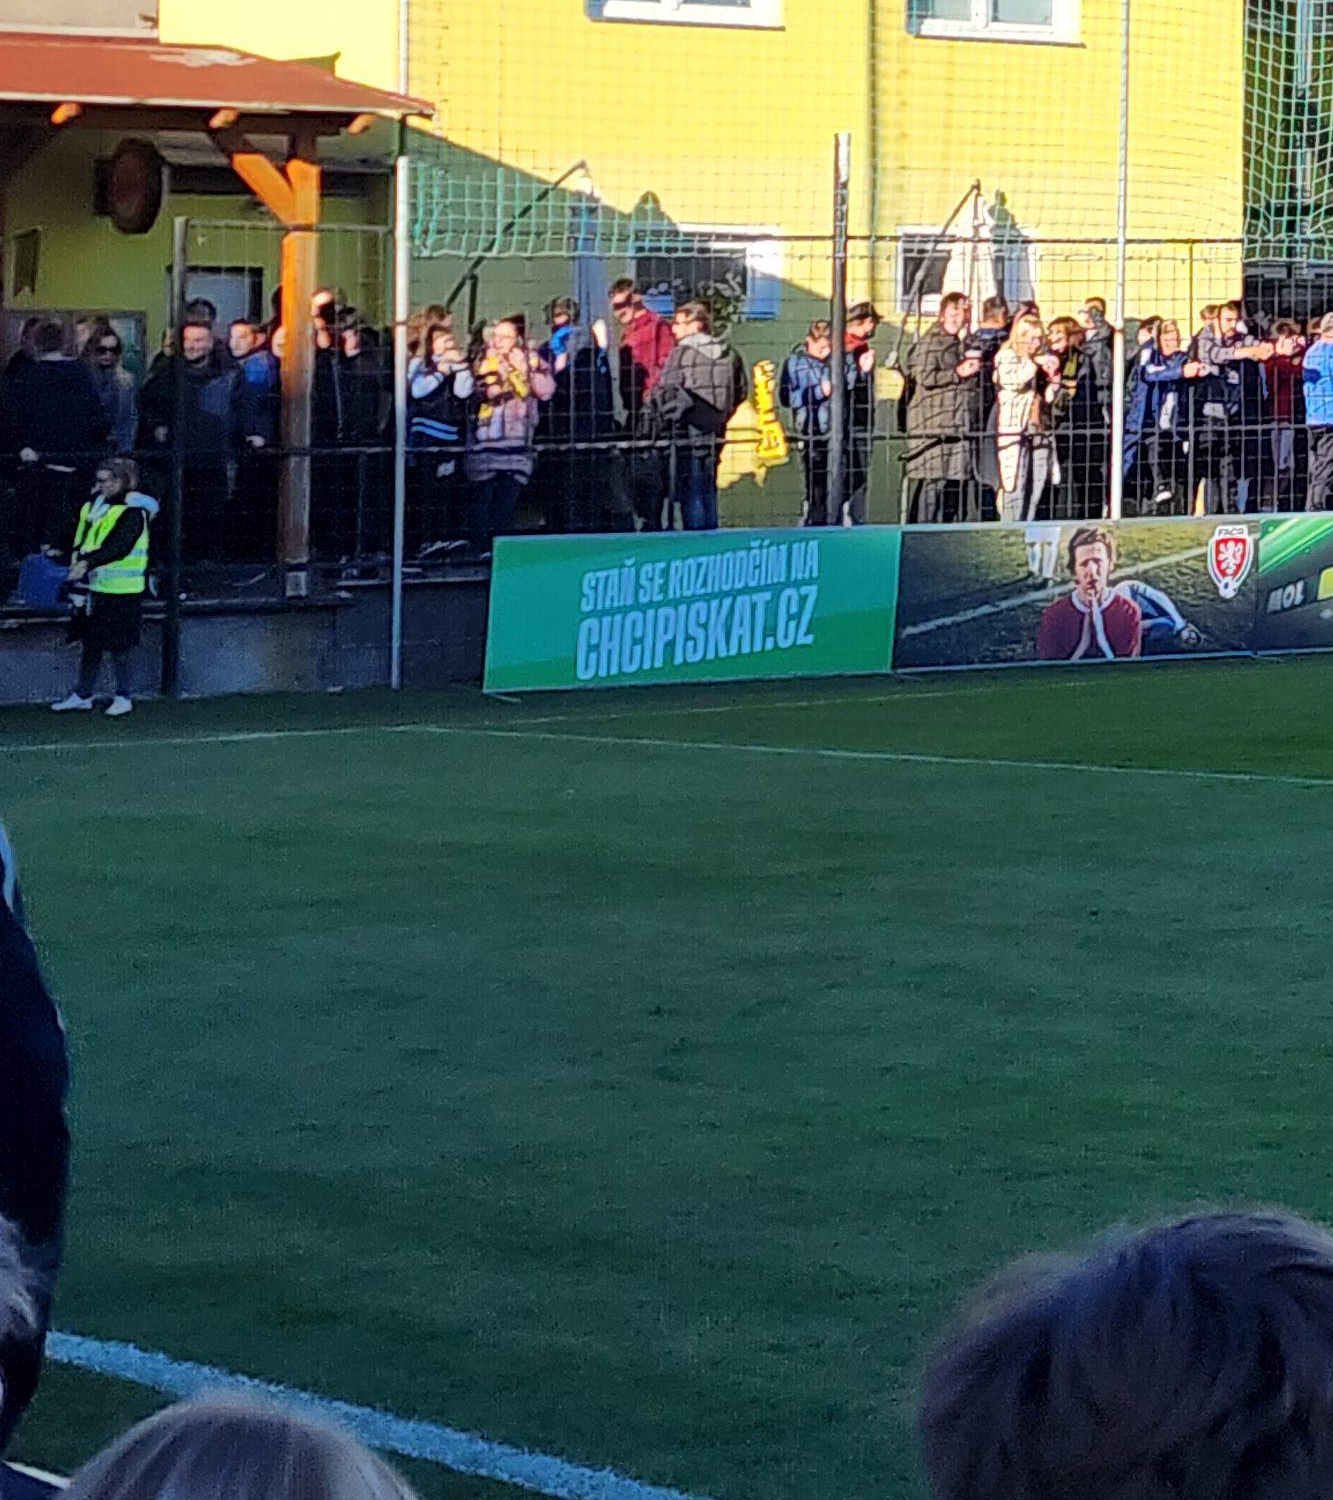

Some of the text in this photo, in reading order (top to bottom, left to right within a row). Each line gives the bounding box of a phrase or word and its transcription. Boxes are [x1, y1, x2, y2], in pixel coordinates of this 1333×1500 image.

[580, 539, 820, 612] STAŇ SE ROZHODČÍM NA
[576, 584, 819, 681] CHCIPISKAT.CZ
